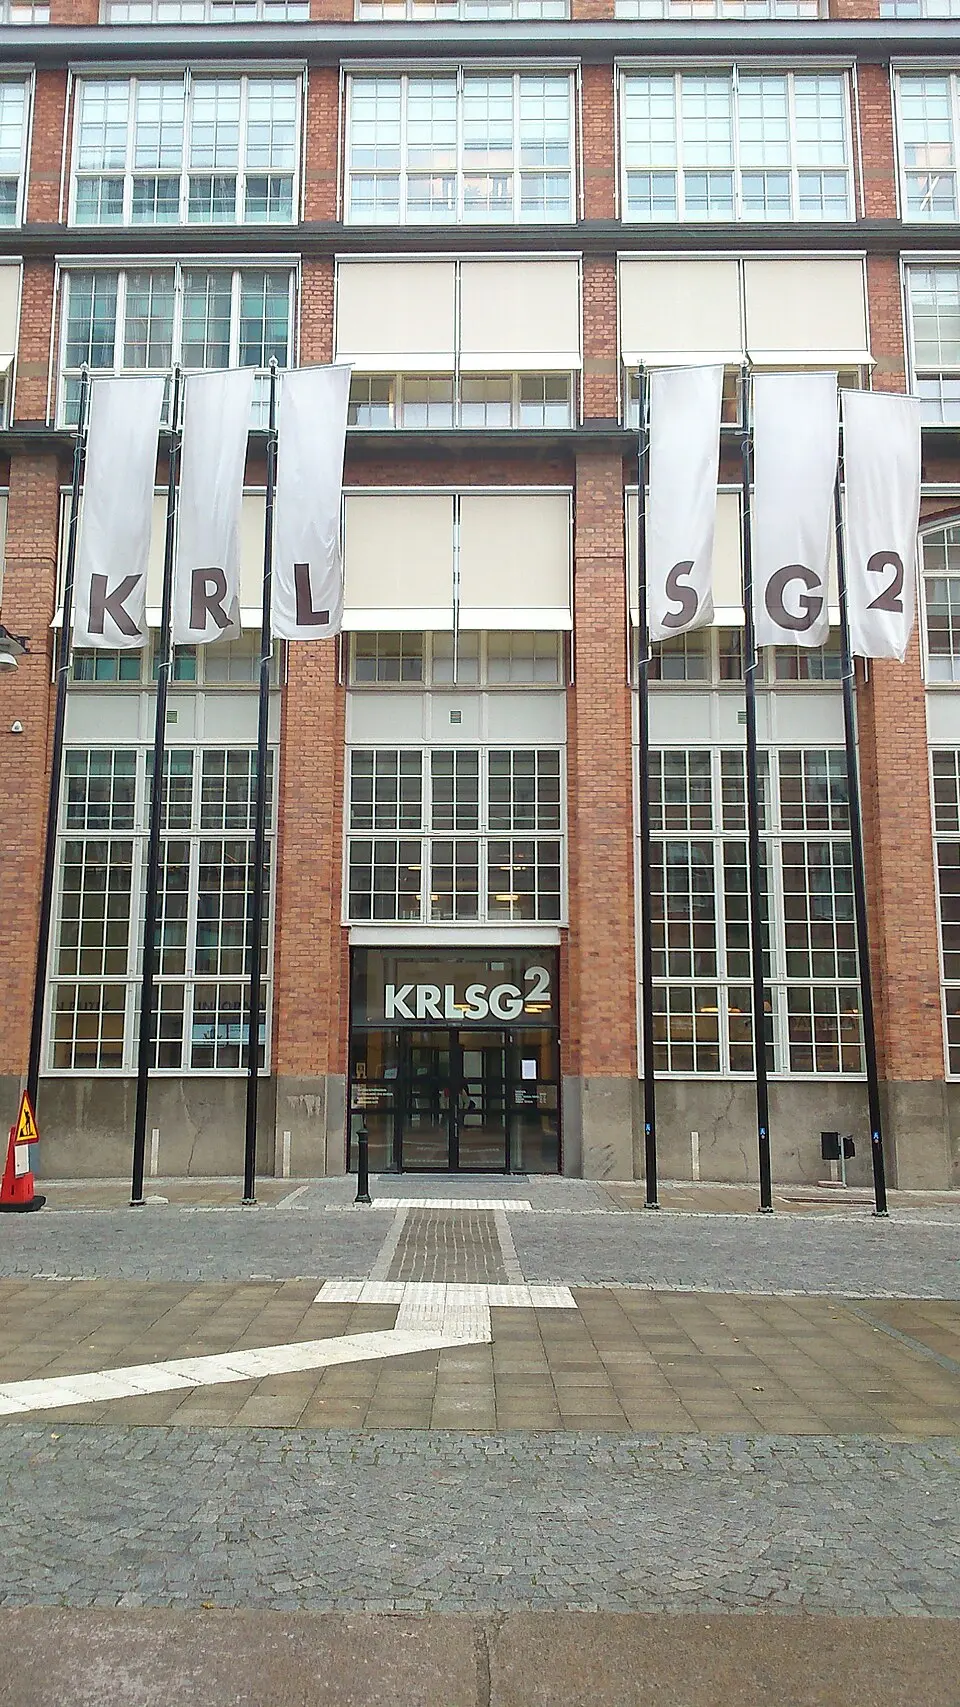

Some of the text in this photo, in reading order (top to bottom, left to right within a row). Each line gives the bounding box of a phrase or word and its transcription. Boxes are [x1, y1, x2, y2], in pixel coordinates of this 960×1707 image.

[87, 572, 143, 636] K
[189, 567, 234, 630] R
[293, 563, 330, 626] L
[661, 560, 699, 629] S
[764, 563, 824, 632] G
[866, 550, 904, 613] 2
